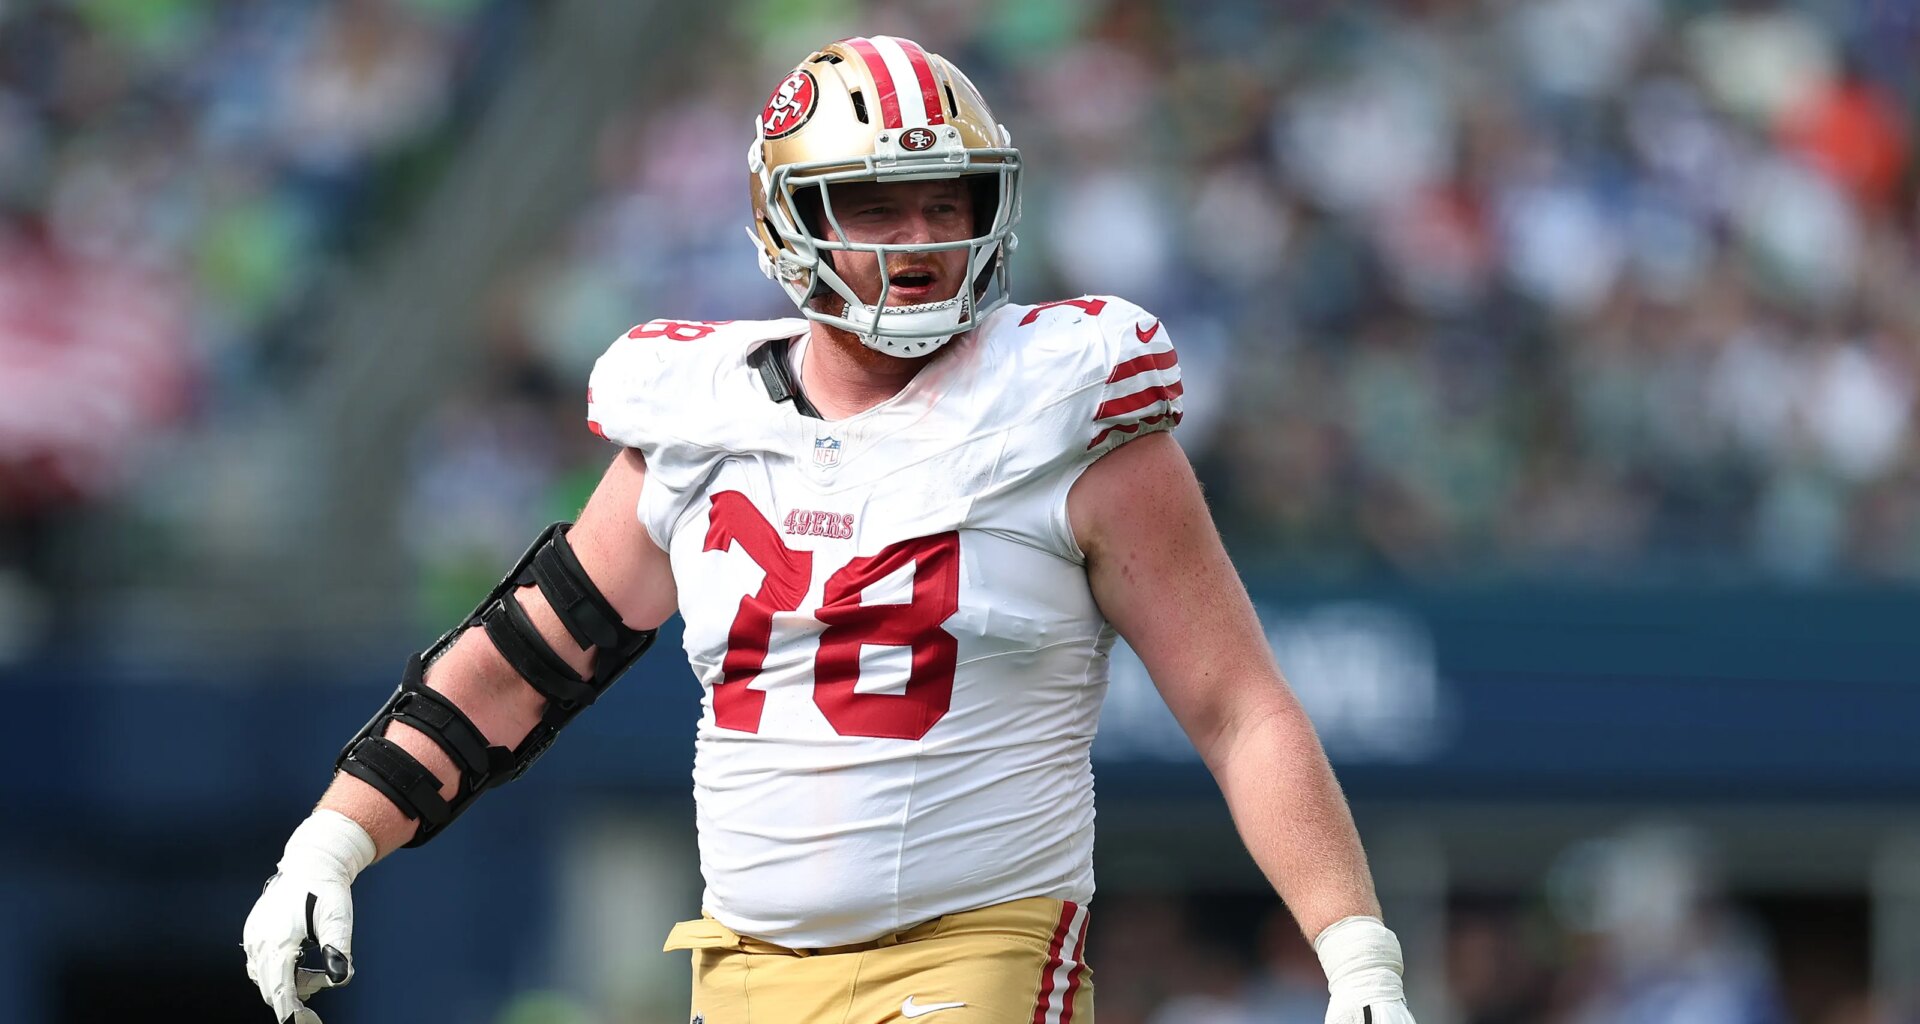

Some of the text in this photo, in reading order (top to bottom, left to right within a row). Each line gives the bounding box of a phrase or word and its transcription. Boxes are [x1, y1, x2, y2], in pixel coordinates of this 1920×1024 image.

[816, 449, 837, 464] NFL
[783, 508, 855, 539] 49ERS
[702, 490, 960, 740] 78
